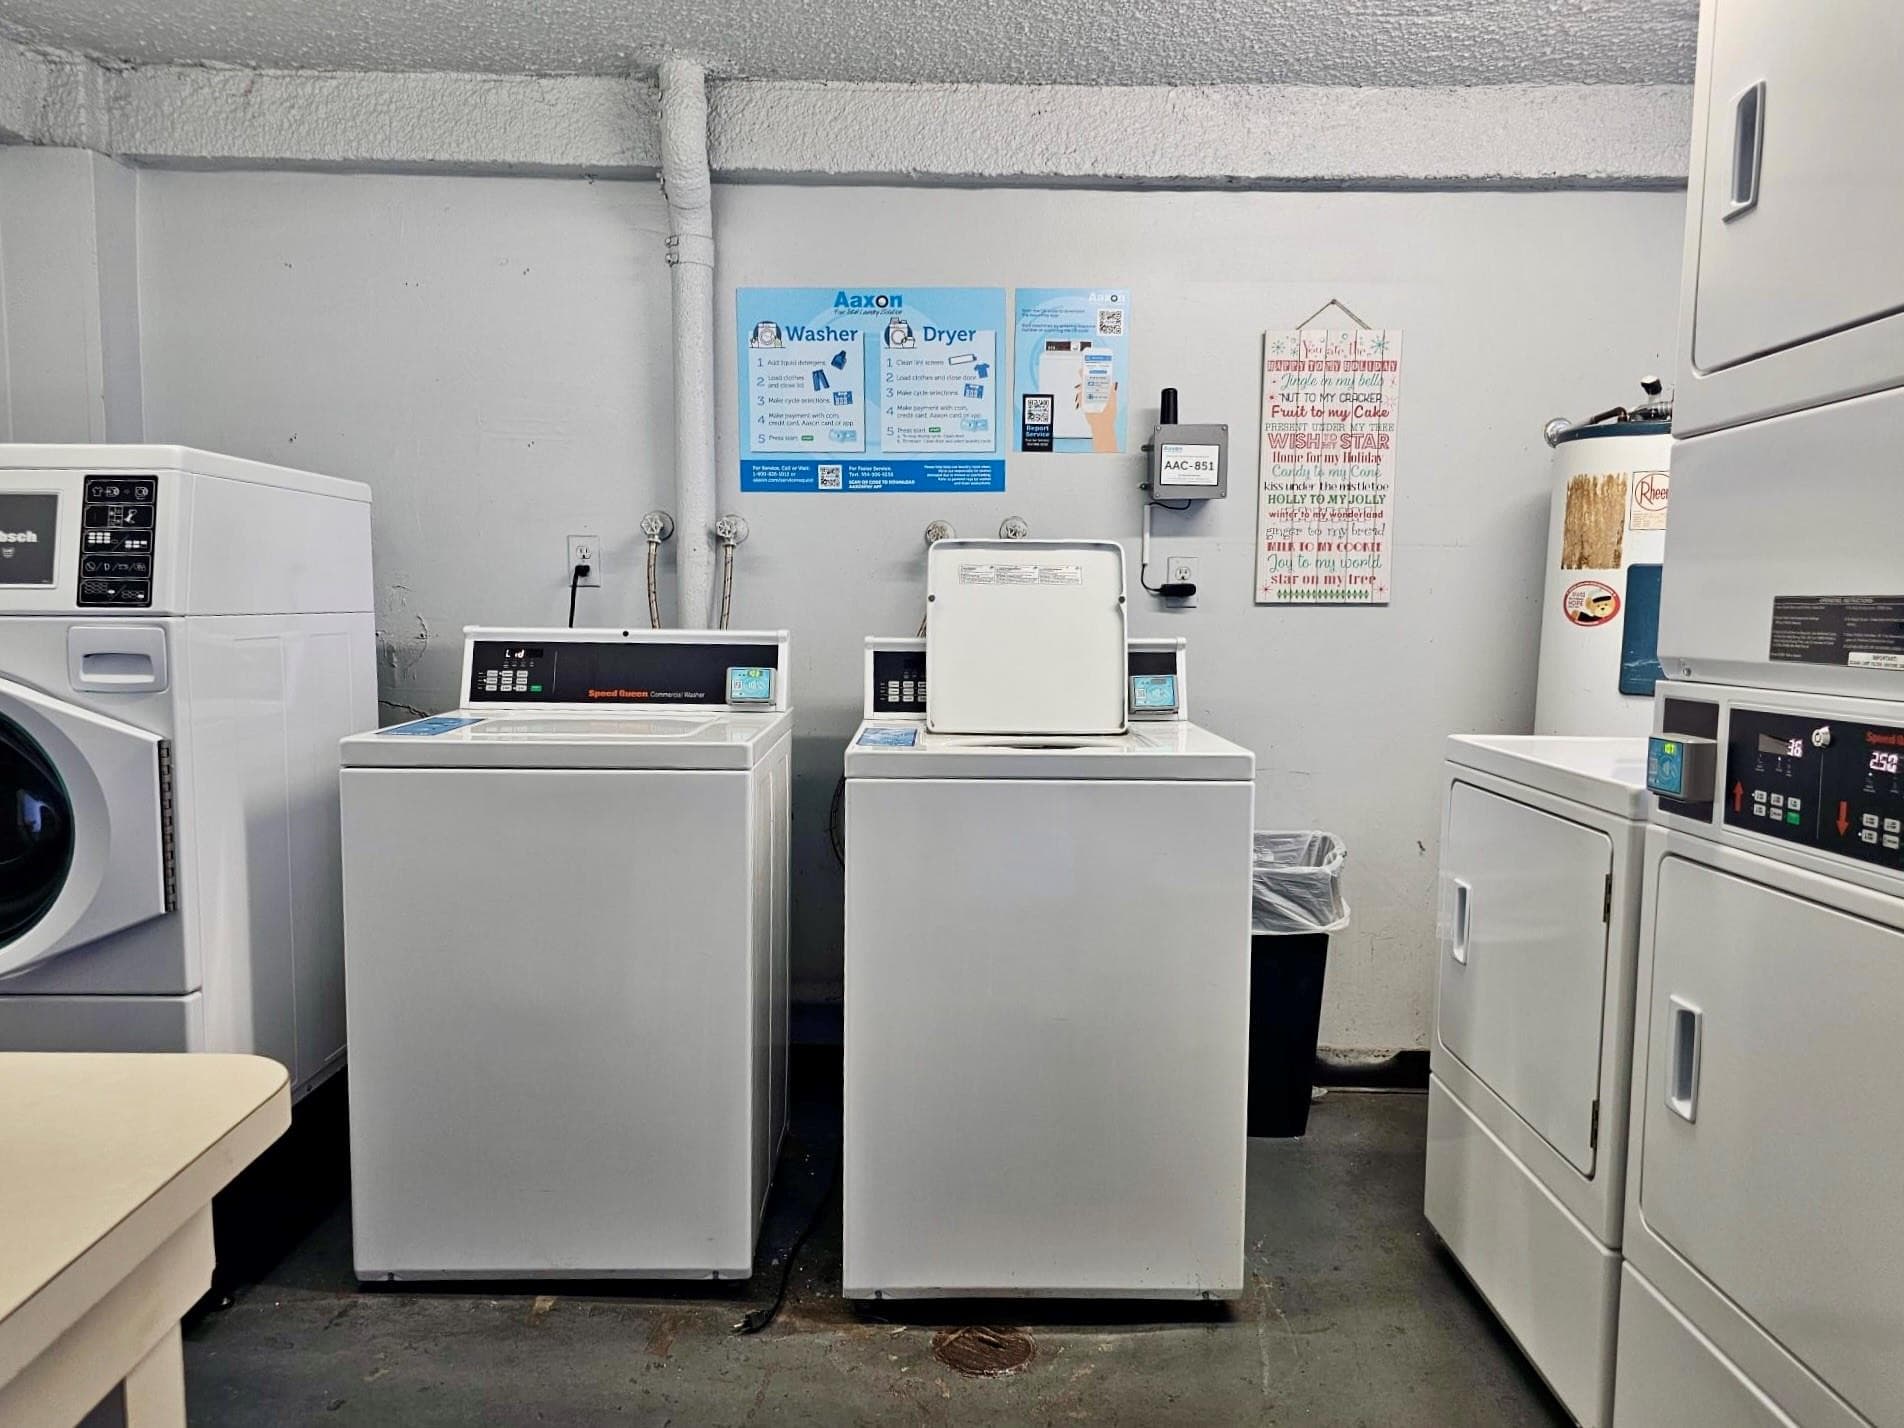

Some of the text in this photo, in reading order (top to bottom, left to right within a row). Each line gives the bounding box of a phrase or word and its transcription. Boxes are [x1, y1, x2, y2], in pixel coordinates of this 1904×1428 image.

[833, 291, 903, 308] Aaxon
[785, 326, 858, 342] Washer
[923, 327, 976, 346] Dryer
[1303, 340, 1322, 359] You
[757, 358, 764, 367] 1
[887, 358, 893, 368] 1
[1267, 360, 1397, 372] HAPPY TO MY HOLIDAY
[757, 377, 765, 387] 2
[886, 373, 894, 383] 2
[1280, 373, 1317, 390] Jingle
[1335, 378, 1354, 391] my
[1359, 373, 1384, 386] bells
[886, 388, 894, 397] 3
[757, 396, 765, 406] 3
[1279, 393, 1383, 403] NUT TO MY CRACKER
[886, 407, 894, 416] 4
[1272, 405, 1389, 421] Fruit to my Cake
[757, 415, 765, 424] 4
[887, 427, 894, 436] 5
[1265, 423, 1395, 432] PRESENT UNDER MY TREE
[758, 434, 766, 443] 5
[1267, 433, 1320, 449] WISH
[1323, 433, 1338, 441] TO
[1340, 433, 1390, 449] STAR
[1272, 452, 1382, 466] Home for my Holiday
[1164, 461, 1214, 471] AAC-851
[1272, 464, 1381, 480] Candy to my Cane
[1264, 481, 1389, 491] kiss under the mistletoe
[1268, 494, 1386, 504] HOLLY TO MY JOLLY
[1269, 510, 1384, 521] winter to my wonderland
[1265, 522, 1386, 541] ginger to my bread
[1267, 542, 1381, 552] MILK TO MY COOKIE
[1267, 553, 1383, 573] Joy to my world
[1271, 574, 1377, 587] star on my tree
[588, 689, 618, 698] Speed
[619, 689, 649, 698] Queen
[650, 690, 683, 698] Commercial
[1787, 739, 1803, 758] 36
